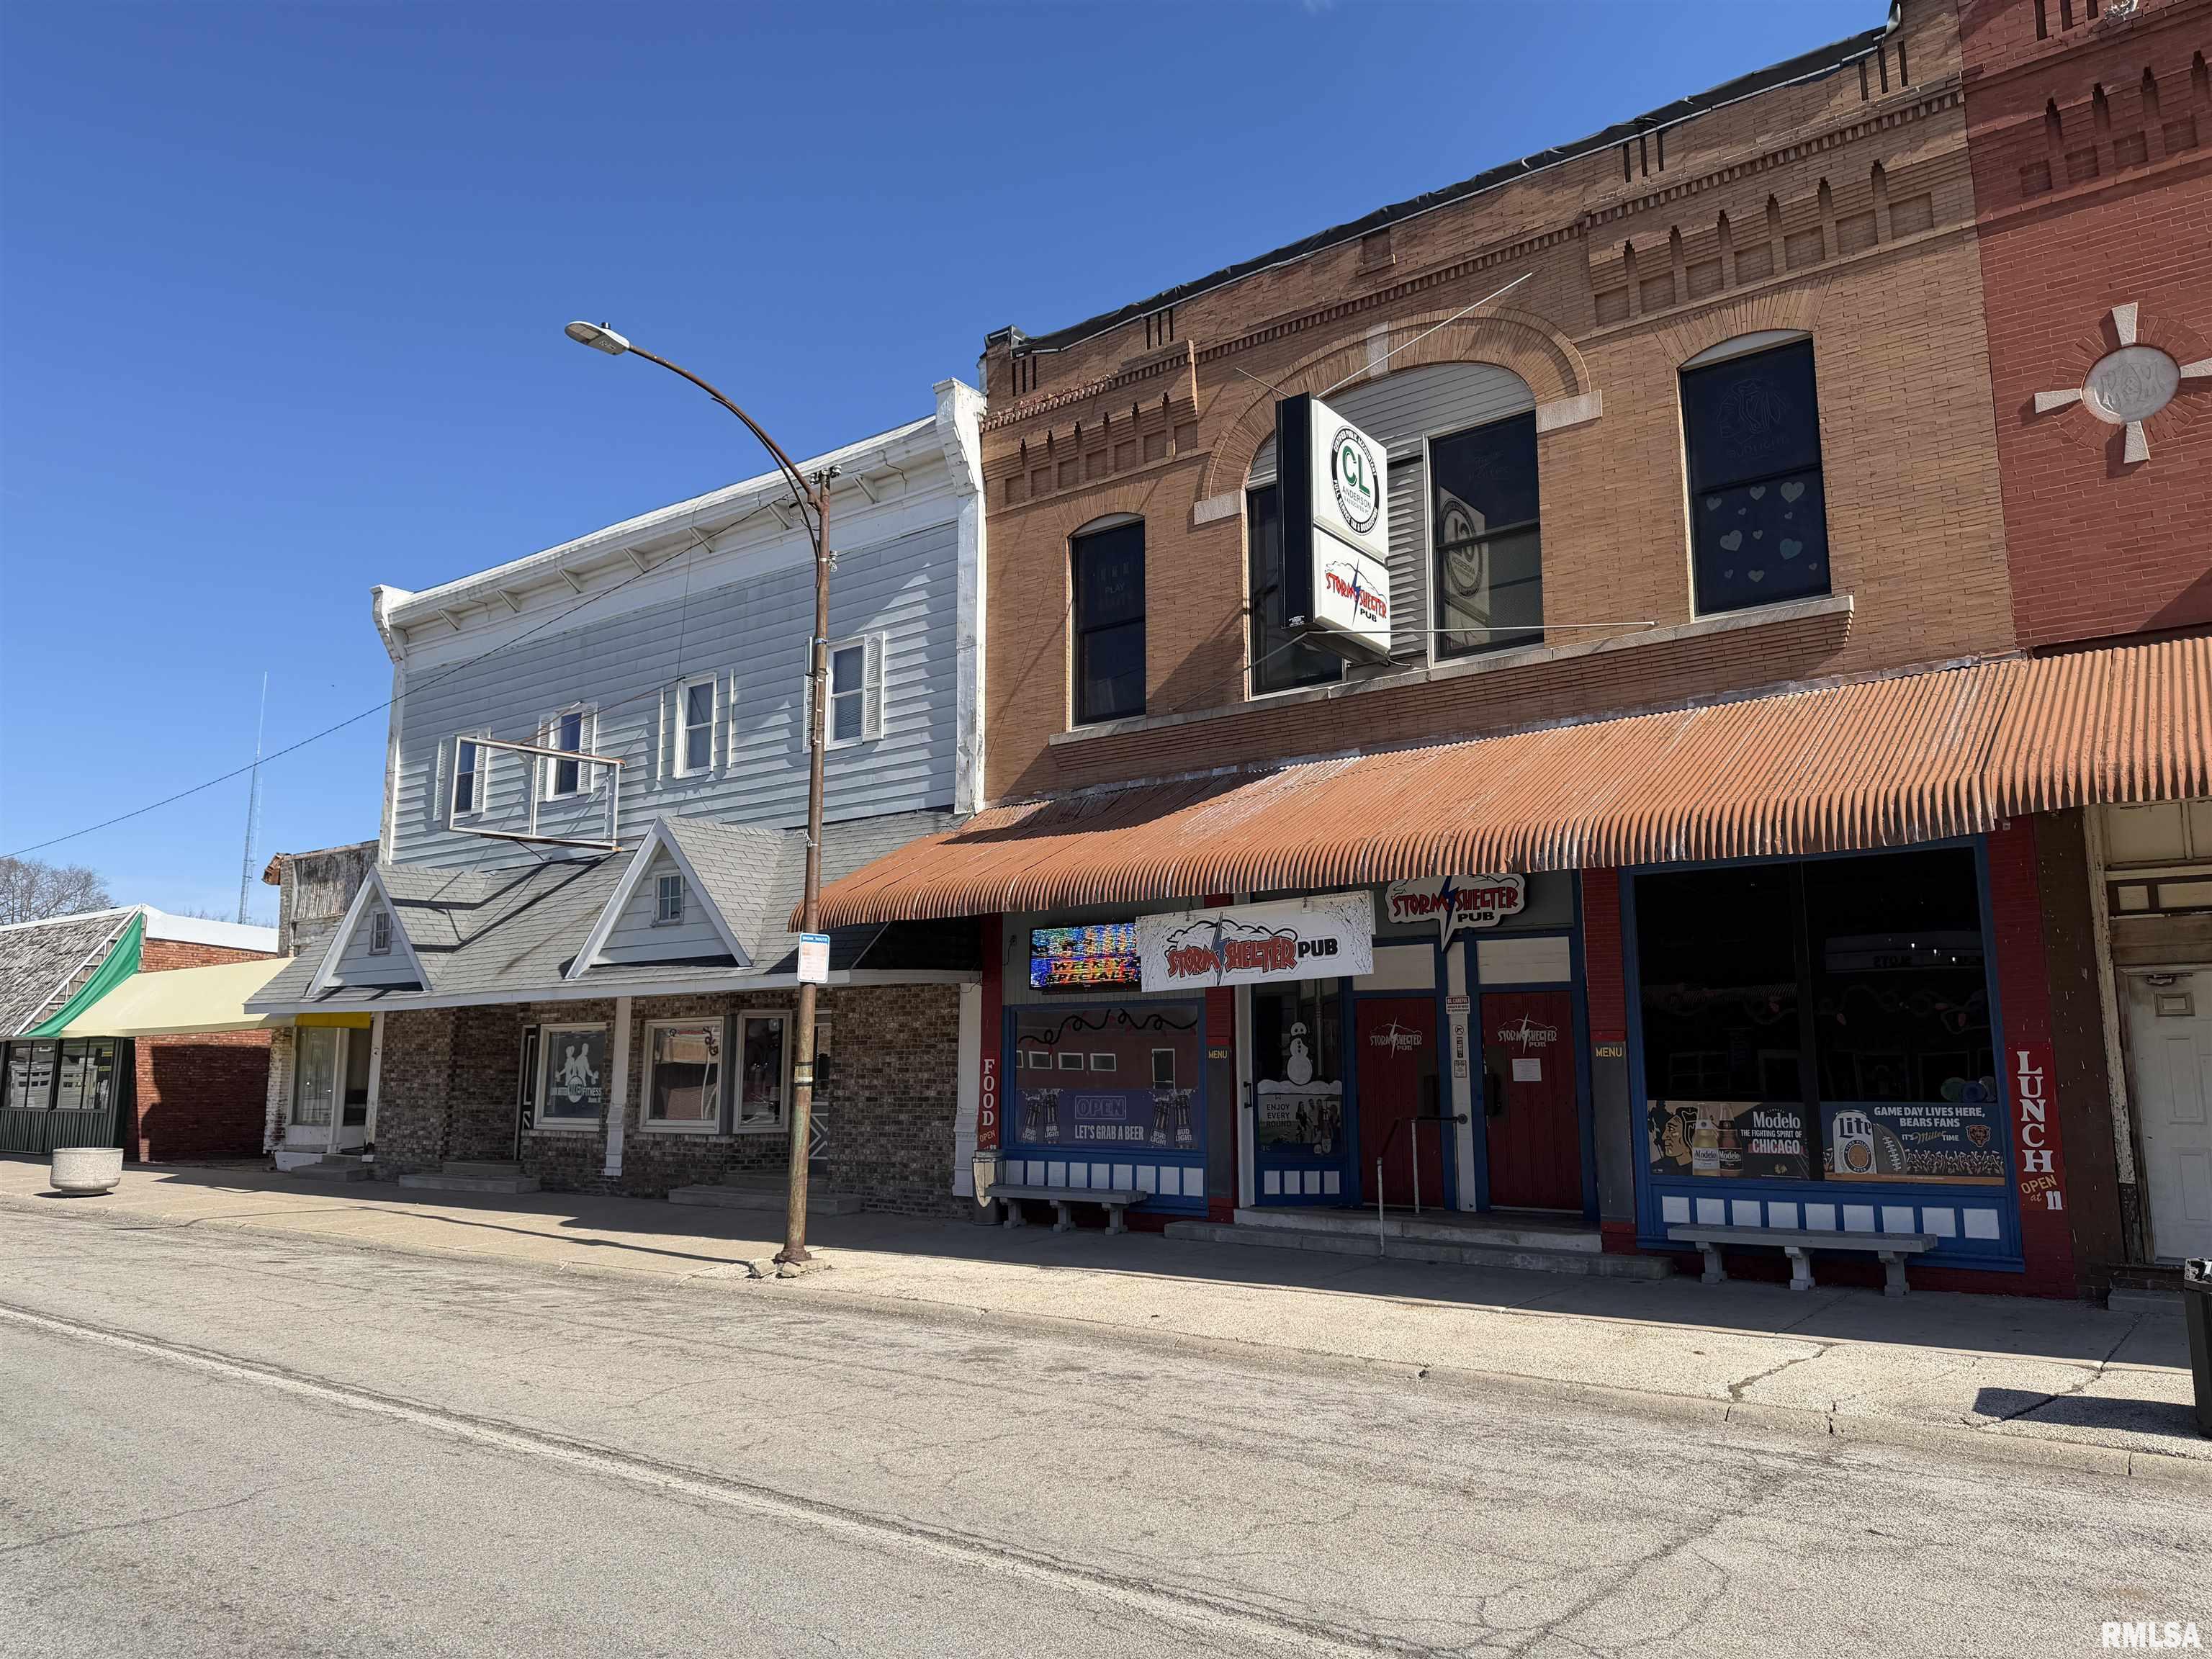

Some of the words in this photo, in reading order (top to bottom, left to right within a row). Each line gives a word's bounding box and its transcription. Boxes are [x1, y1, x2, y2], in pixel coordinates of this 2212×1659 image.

[1342, 446, 1371, 497] CL
[1342, 485, 1371, 509] ANDERSON
[1326, 572, 1357, 603] STORM
[1359, 608, 1377, 622] PUB
[1391, 893, 1450, 917] STORM
[1455, 887, 1519, 912] SHELTER
[1457, 912, 1495, 922] PUB
[1053, 958, 1128, 971] WEEKLY
[1167, 945, 1222, 978] STORM
[1224, 935, 1298, 974] SHELTER
[1297, 938, 1338, 958] PUB
[1208, 1050, 1228, 1059] MENU
[1596, 1047, 1622, 1057] MENU
[982, 1058, 995, 1126] FOOD
[1076, 1097, 1125, 1117] OPEN
[1874, 1107, 1902, 1116] GAME
[1904, 1107, 1925, 1117] DAY
[1926, 1107, 1954, 1117] LIVES
[1954, 1107, 1986, 1118] HERE,
[2017, 1051, 2055, 1173] LUNCH
[1753, 1111, 1800, 1129] Modelo
[1838, 1118, 1872, 1138] Lite
[1899, 1118, 1929, 1127] BEARS
[1930, 1118, 1960, 1128] FANS
[979, 1129, 996, 1142] OPEN
[1074, 1125, 1095, 1140] LET'S
[1096, 1125, 1118, 1141] GRAB
[1118, 1125, 1123, 1141] A
[1124, 1125, 1144, 1141] BEER
[1751, 1129, 1776, 1138] FIGHTING
[1914, 1130, 1947, 1144] Miller
[1752, 1138, 1800, 1154] CHICAGO
[1695, 1150, 1717, 1159] Modelo
[1719, 1151, 1740, 1159] Modelo
[2020, 1174, 2057, 1194] OPEN
[2046, 1190, 2063, 1210] 11
